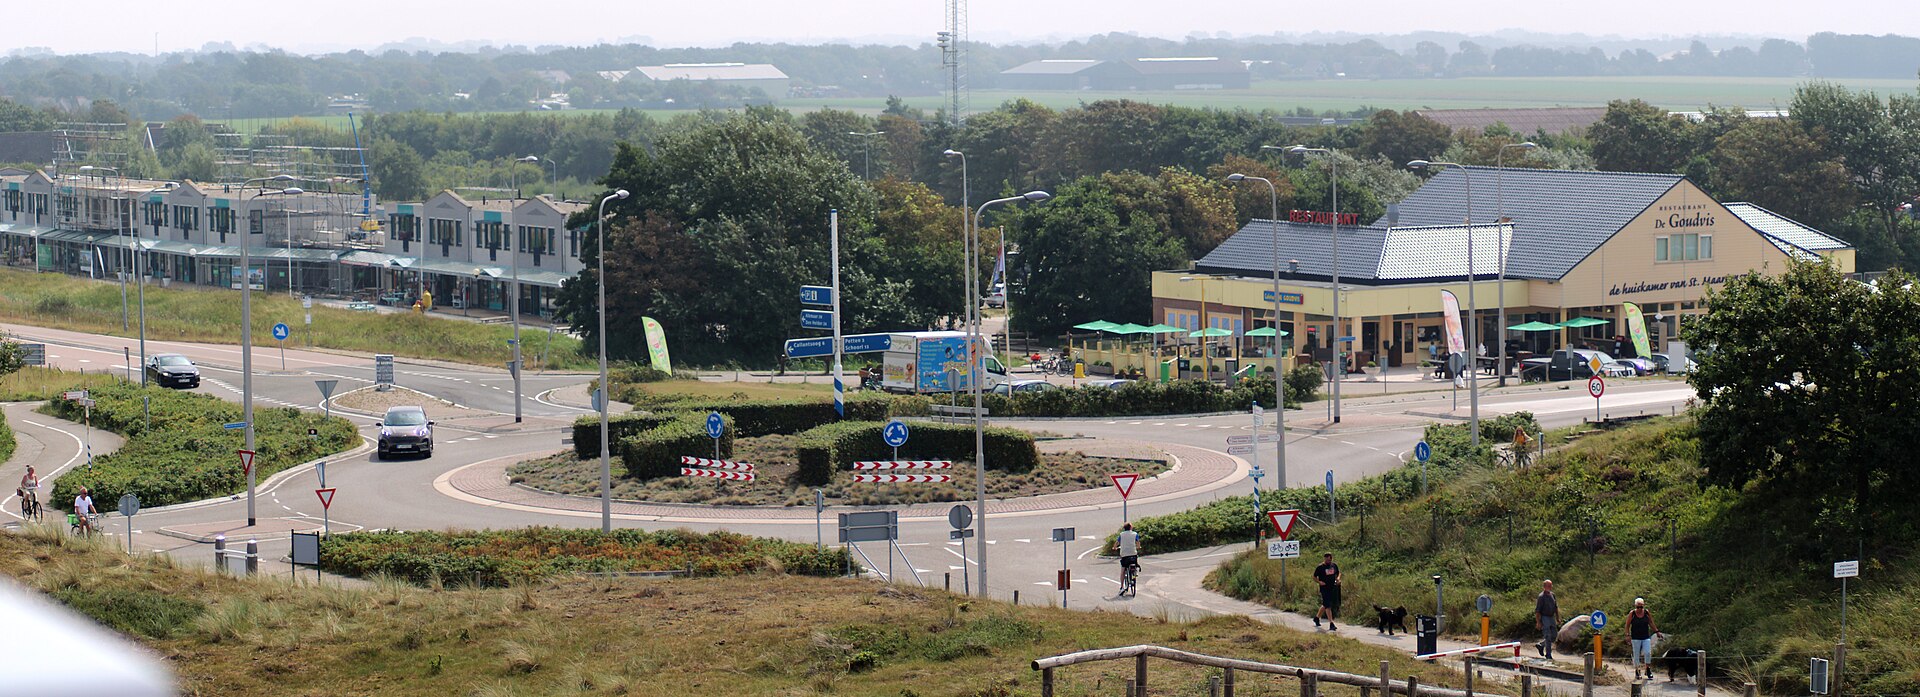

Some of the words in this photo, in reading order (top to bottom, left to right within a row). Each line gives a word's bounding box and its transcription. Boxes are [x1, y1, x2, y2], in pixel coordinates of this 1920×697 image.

[1289, 209, 1359, 225] RESTAURANT
[1655, 219, 1666, 229] De
[1669, 211, 1715, 228] Goudvis
[1609, 284, 1621, 296] de
[1622, 280, 1668, 294] huiskamer
[1670, 279, 1687, 289] van
[1688, 277, 1700, 287] St.
[1592, 382, 1601, 391] 60
